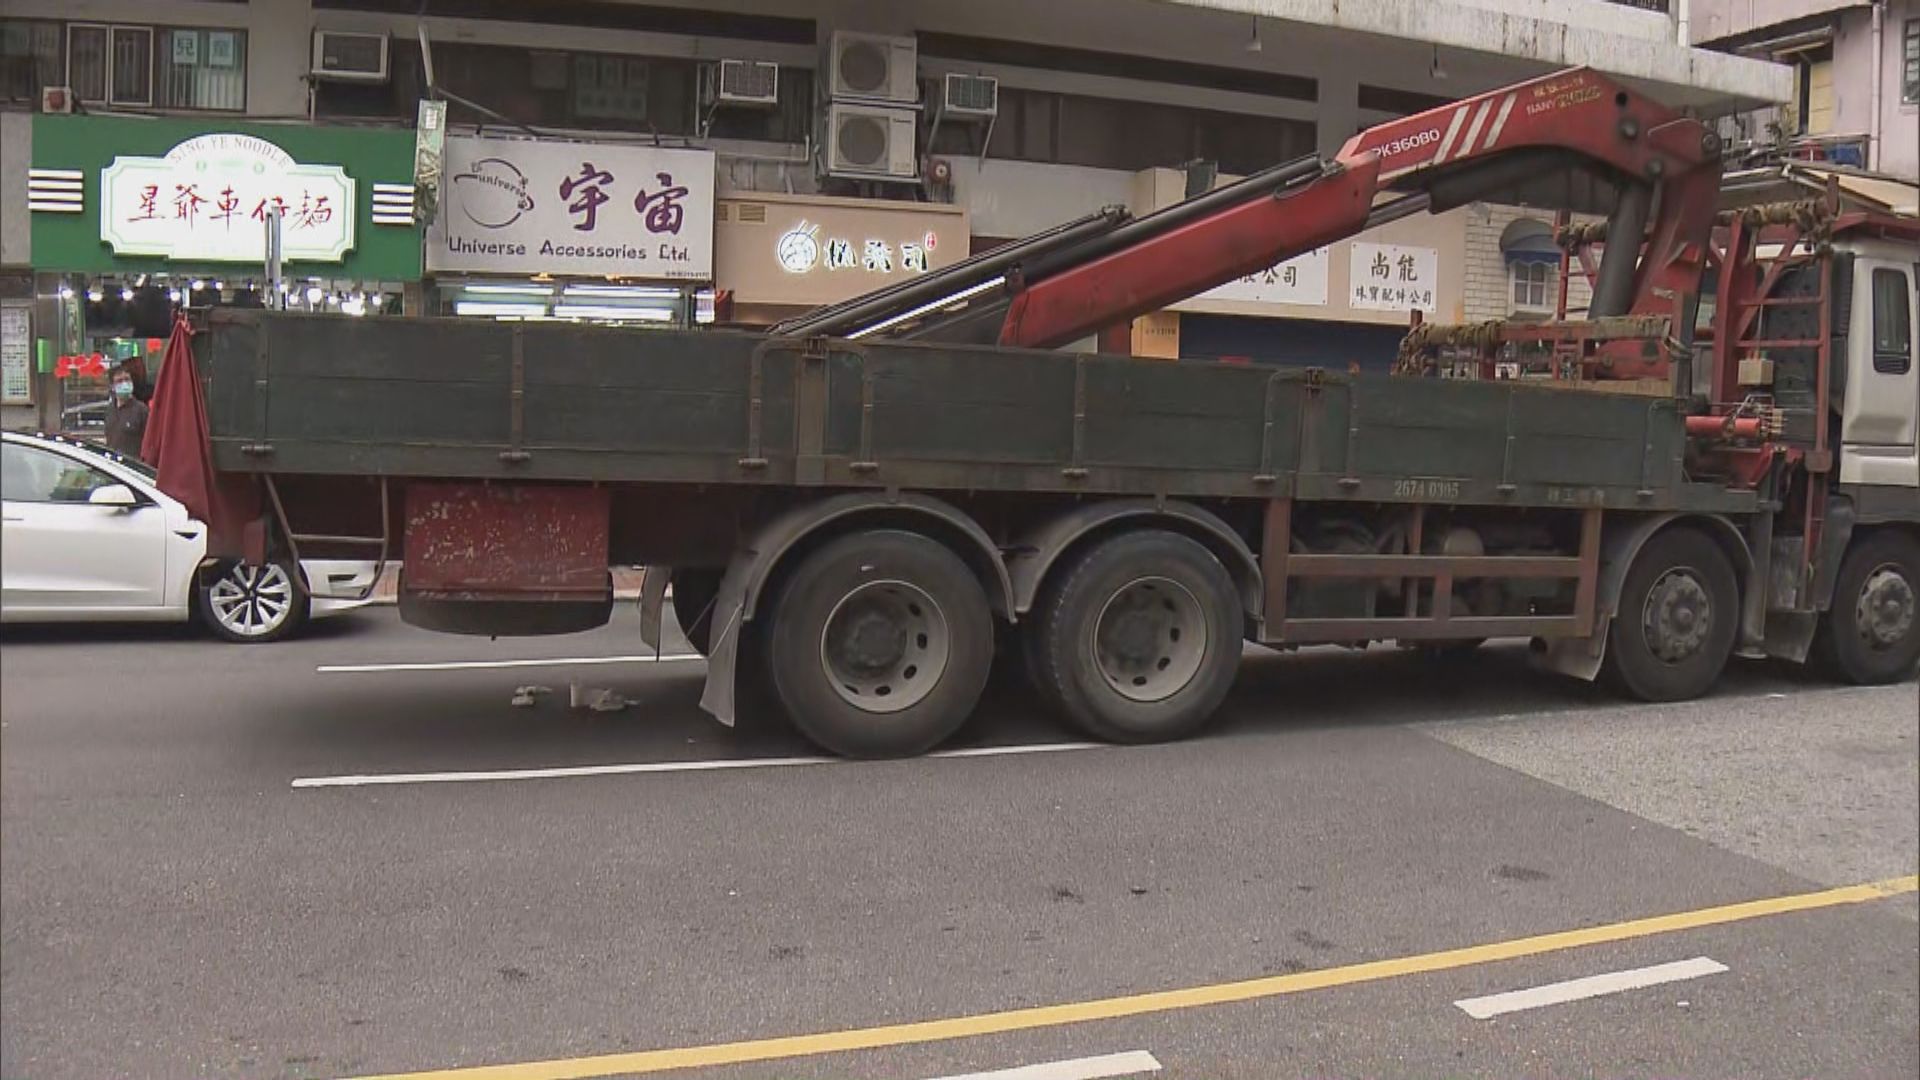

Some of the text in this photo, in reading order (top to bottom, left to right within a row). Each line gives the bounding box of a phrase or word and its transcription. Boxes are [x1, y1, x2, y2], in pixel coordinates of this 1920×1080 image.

[210, 136, 228, 149] YE
[234, 136, 290, 169] NOODLE
[479, 174, 527, 197] universe
[560, 162, 689, 235] 宇宙
[127, 184, 332, 232] 星爺車仔麵
[449, 237, 691, 262] Universe Accessories Ltd.
[1370, 251, 1418, 282] 尚能
[1355, 284, 1432, 305] 珠寶配件公司
[1393, 479, 1425, 497] 2674
